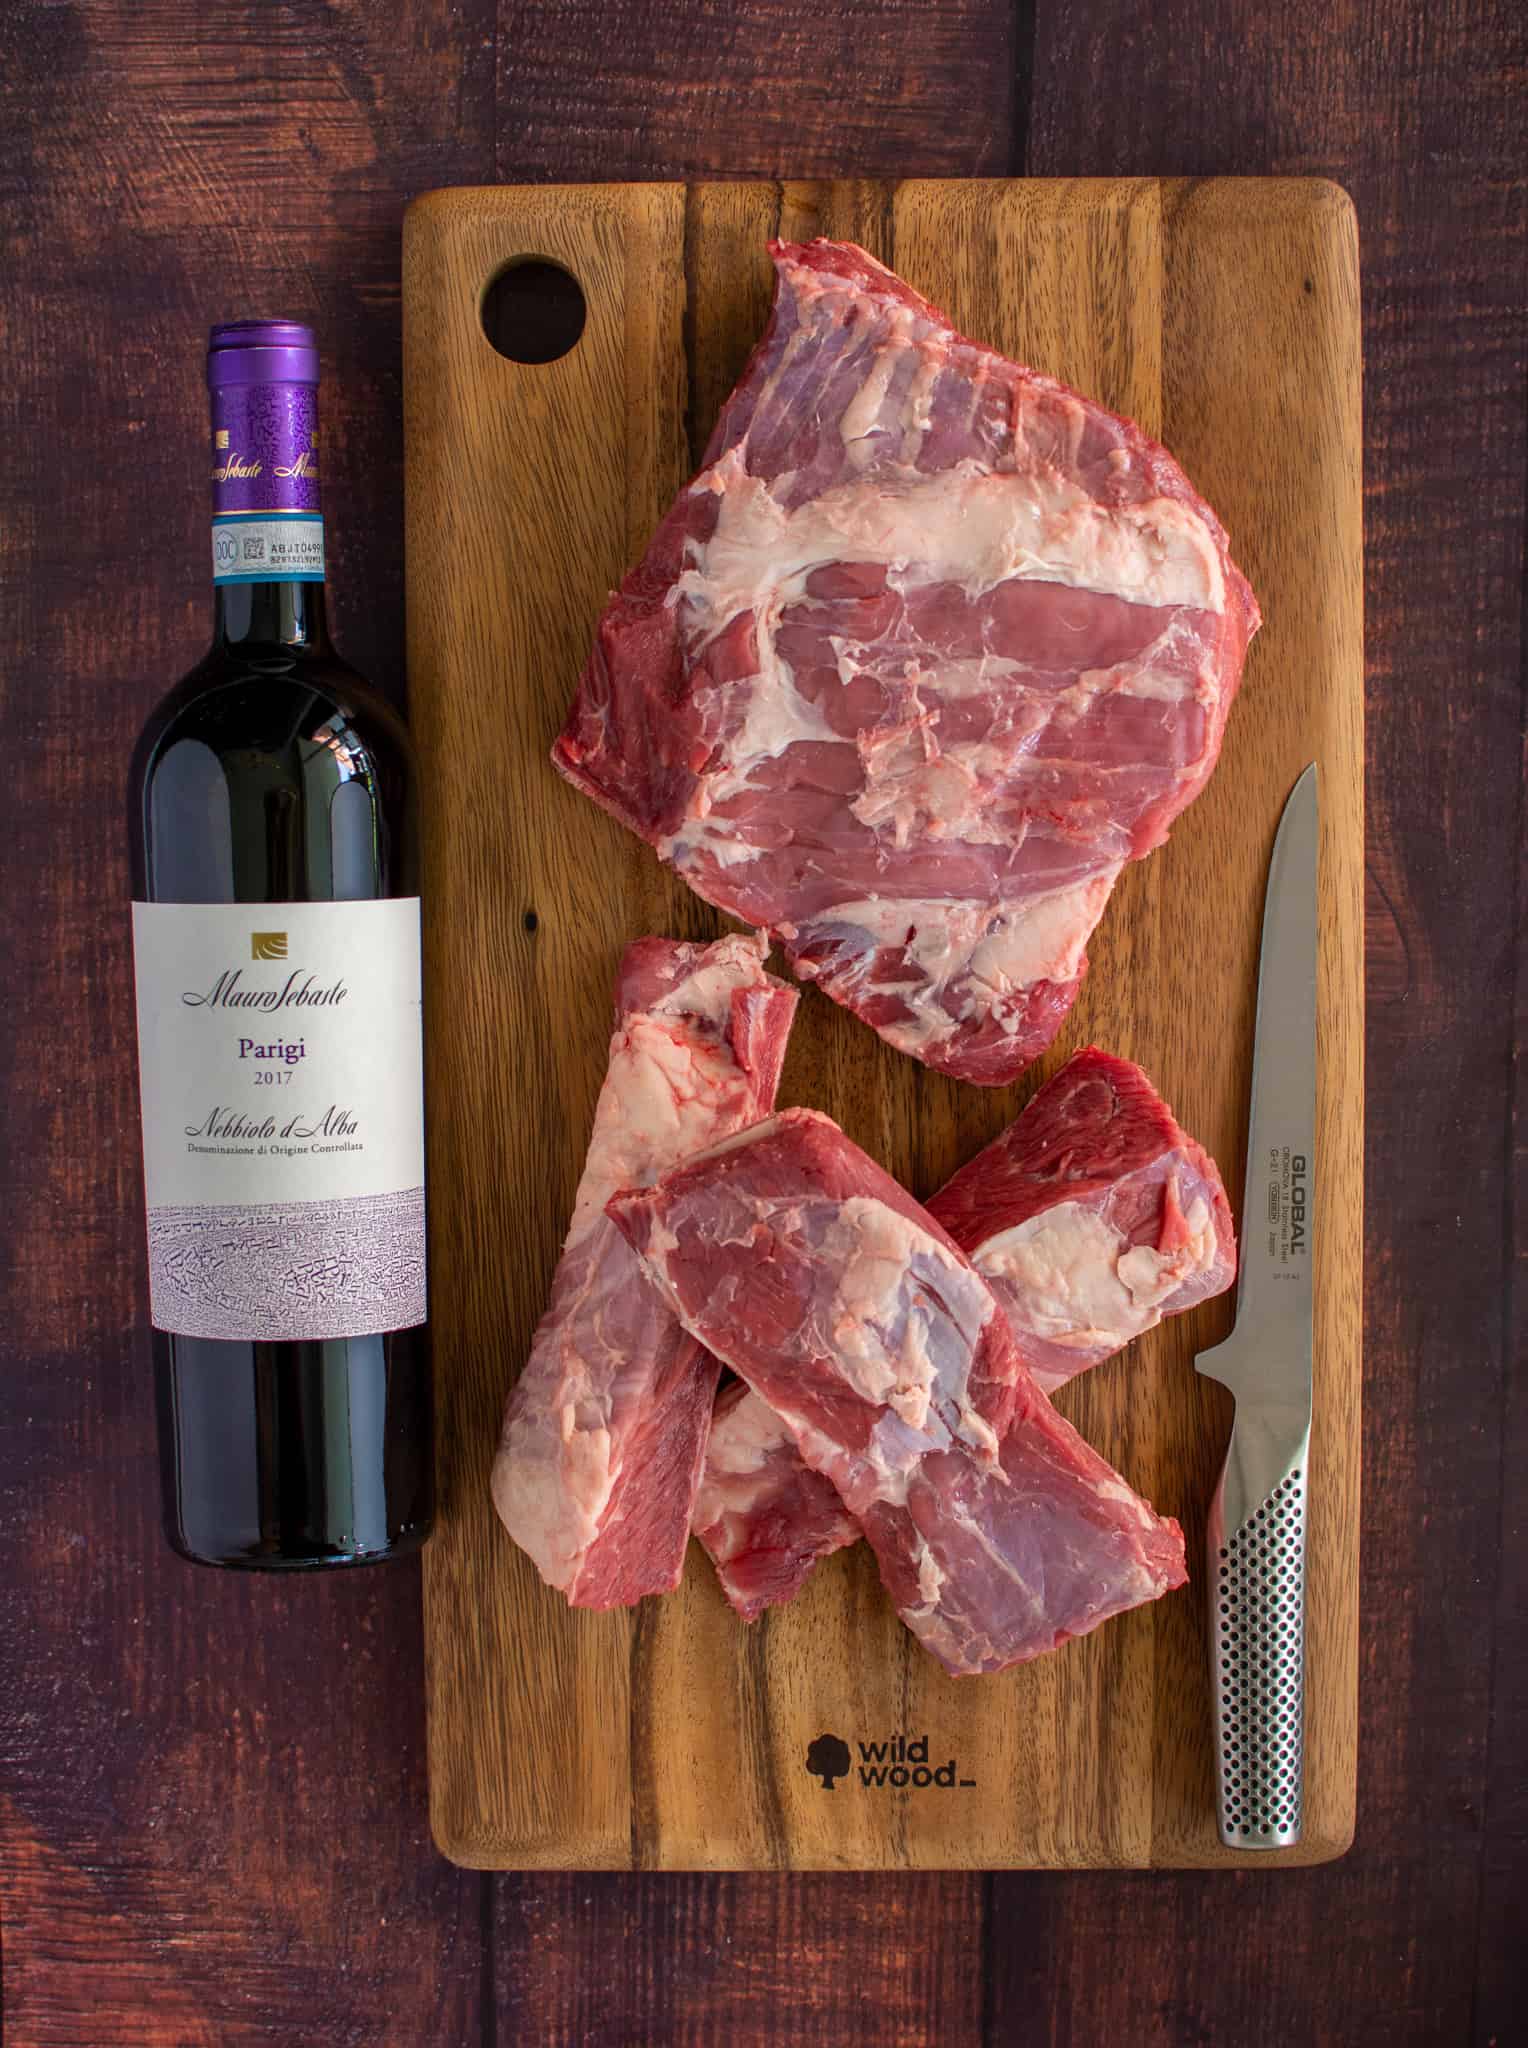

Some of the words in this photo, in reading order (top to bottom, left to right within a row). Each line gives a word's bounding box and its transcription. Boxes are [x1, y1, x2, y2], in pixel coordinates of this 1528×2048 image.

[238, 1037, 306, 1065] Parigi
[253, 1071, 293, 1085] 2017
[184, 1105, 275, 1139] Nebbiolo
[187, 1142, 254, 1155] Denominazione
[257, 1146, 268, 1155] di
[270, 1144, 308, 1157] Origine
[311, 1142, 364, 1153] Controllata
[1291, 1155, 1306, 1255] GLOBAL
[858, 1735, 929, 1763] wild
